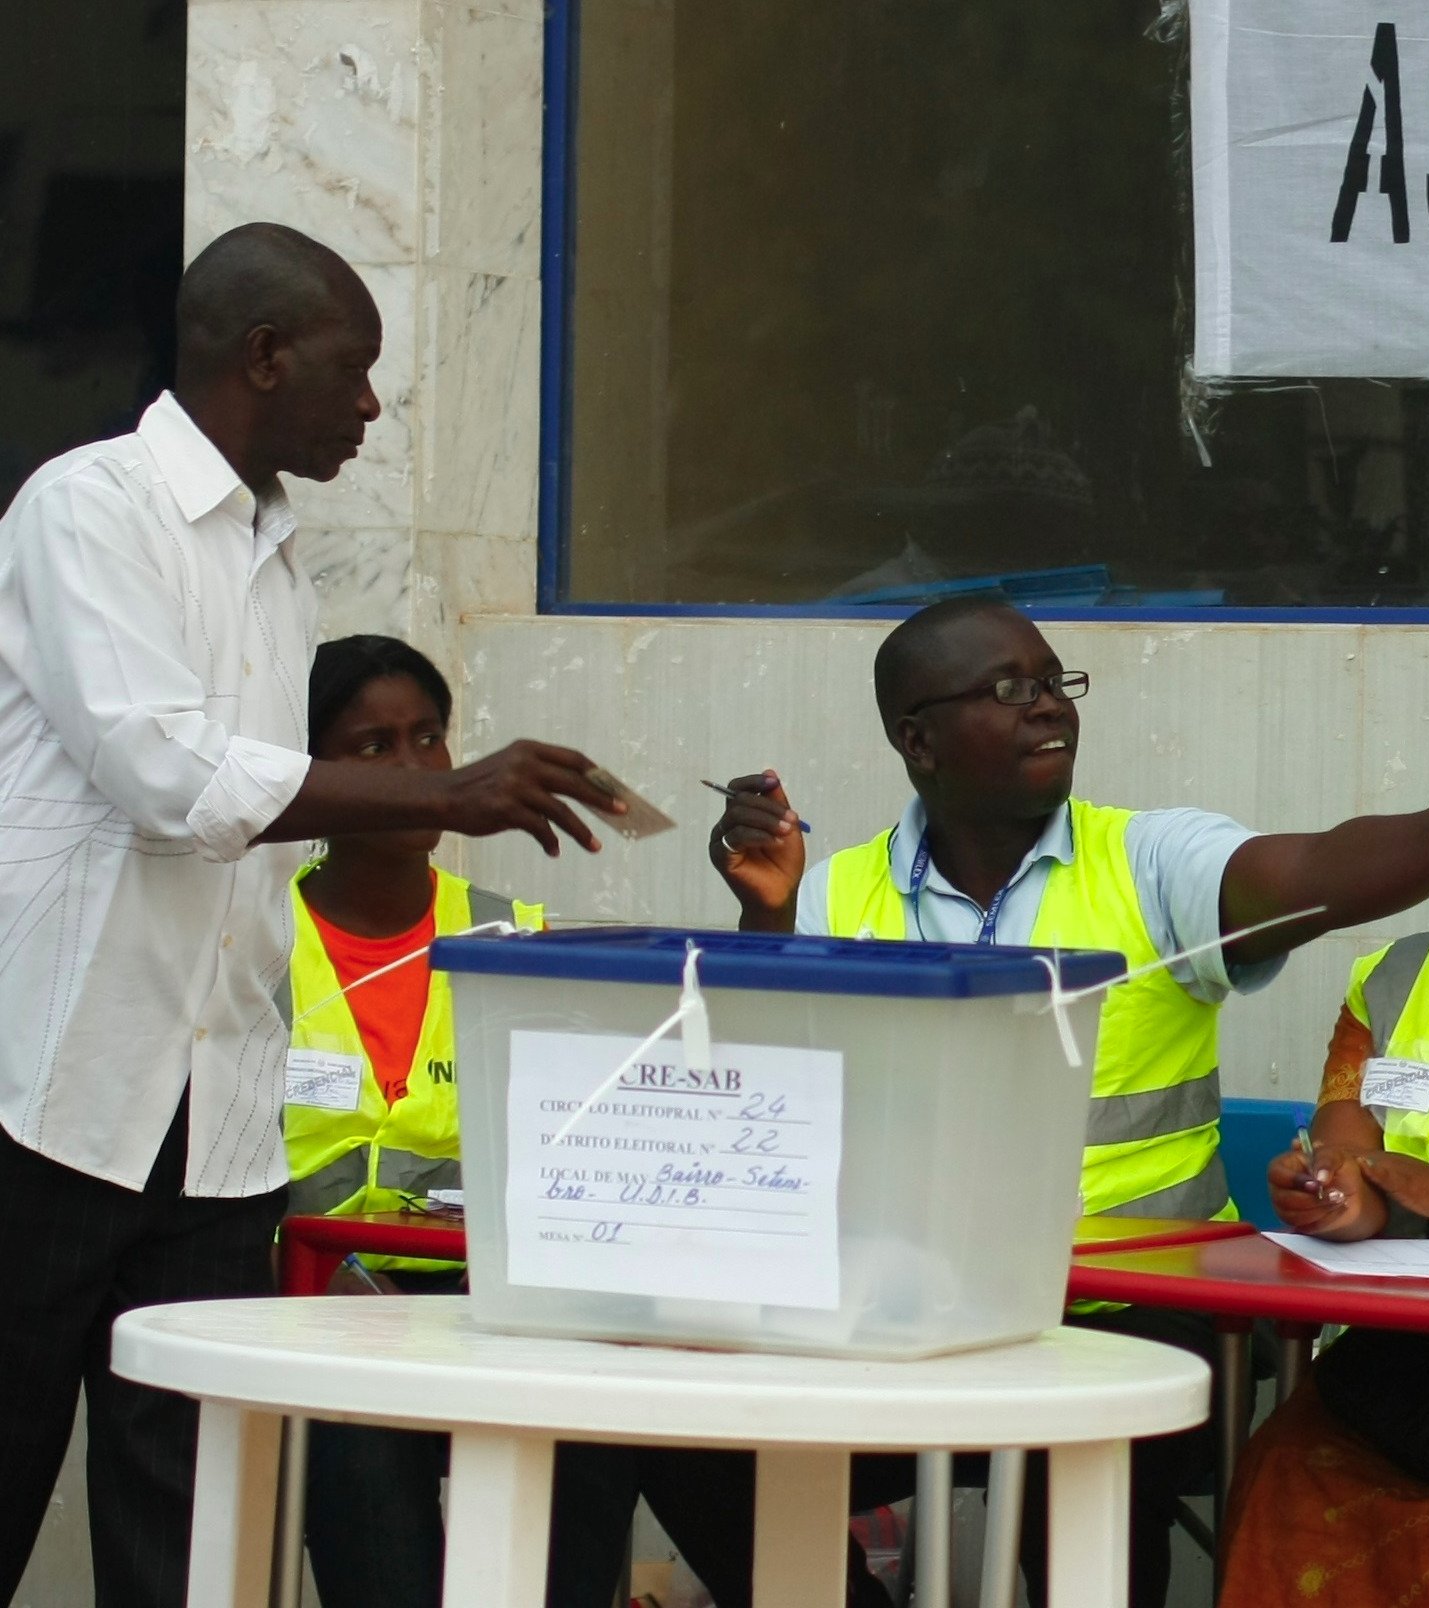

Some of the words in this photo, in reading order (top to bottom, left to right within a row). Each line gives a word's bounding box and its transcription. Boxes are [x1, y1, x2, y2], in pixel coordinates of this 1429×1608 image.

[540, 1100, 608, 1115] CIRCLO
[740, 1091, 785, 1120] 24
[541, 1132, 609, 1150] DSTRITO
[614, 1137, 695, 1155] ELEITORAL
[731, 1126, 779, 1153] 22
[540, 1166, 590, 1182] LOCAL
[594, 1170, 611, 1184] DE
